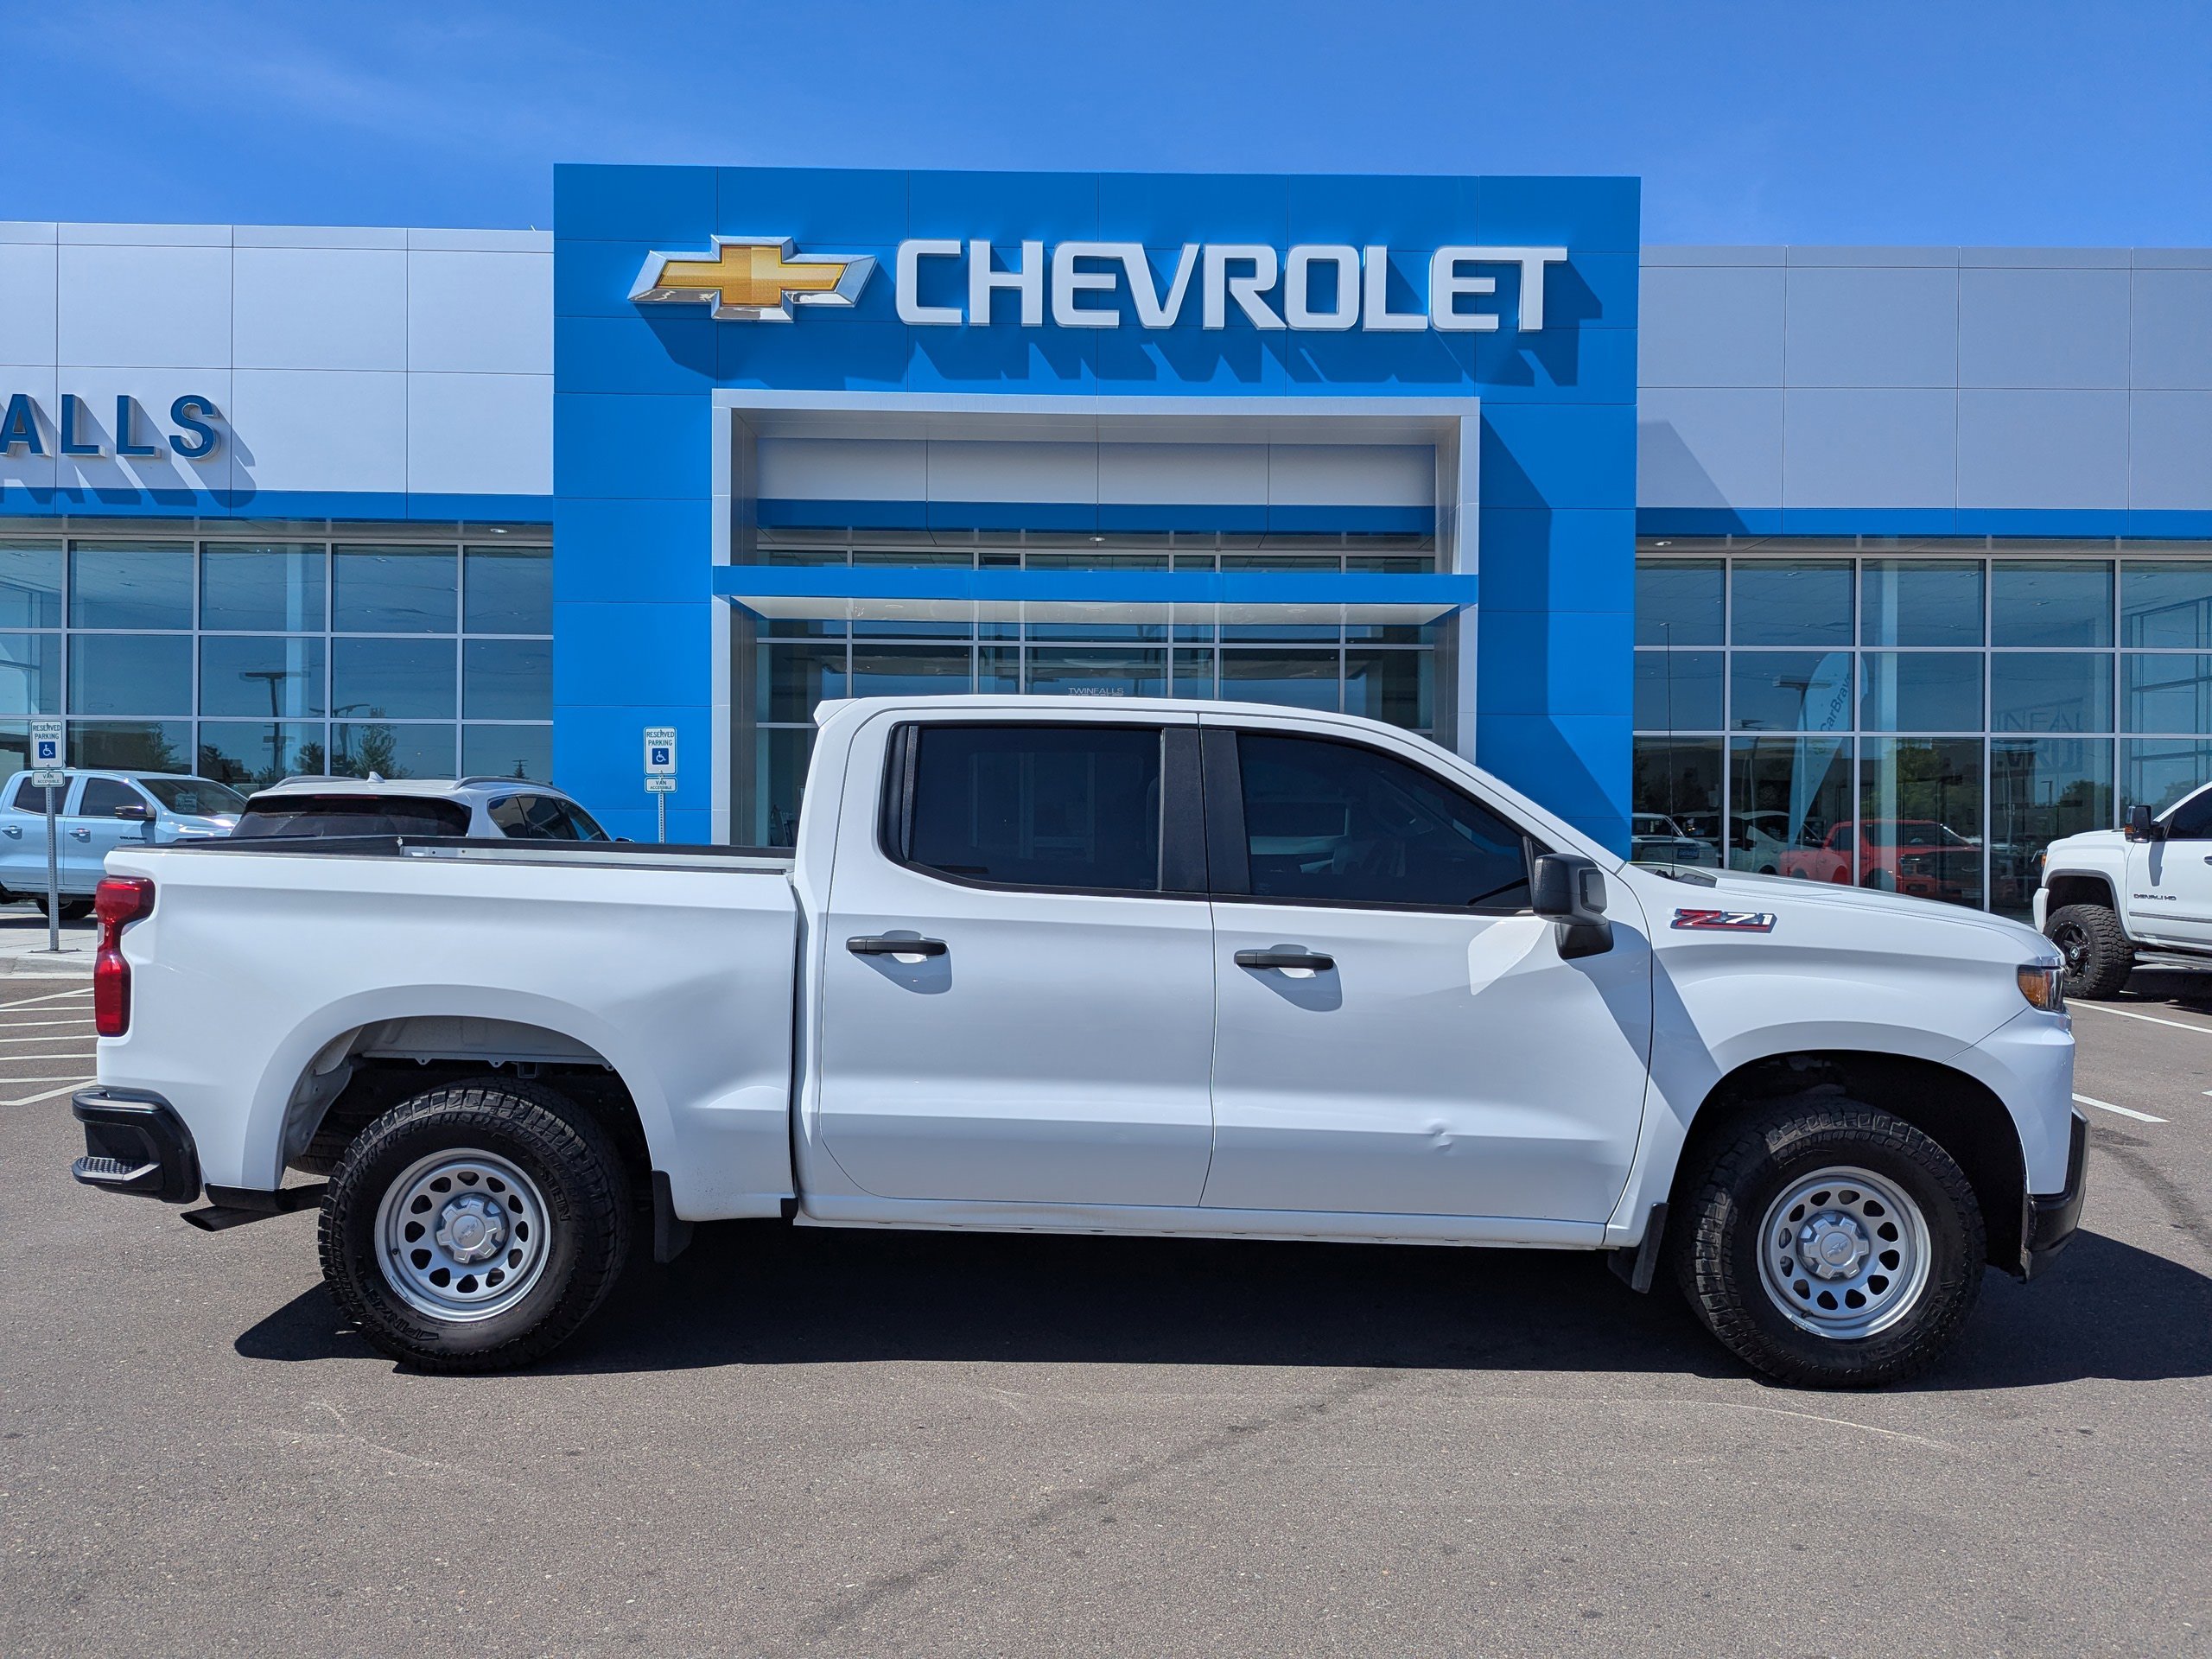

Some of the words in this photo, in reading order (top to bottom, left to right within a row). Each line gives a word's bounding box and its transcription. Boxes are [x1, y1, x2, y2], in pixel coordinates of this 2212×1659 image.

[896, 239, 1567, 333] CHEVROLET
[0, 393, 221, 460] ALLS
[1670, 908, 1777, 933] Z71
